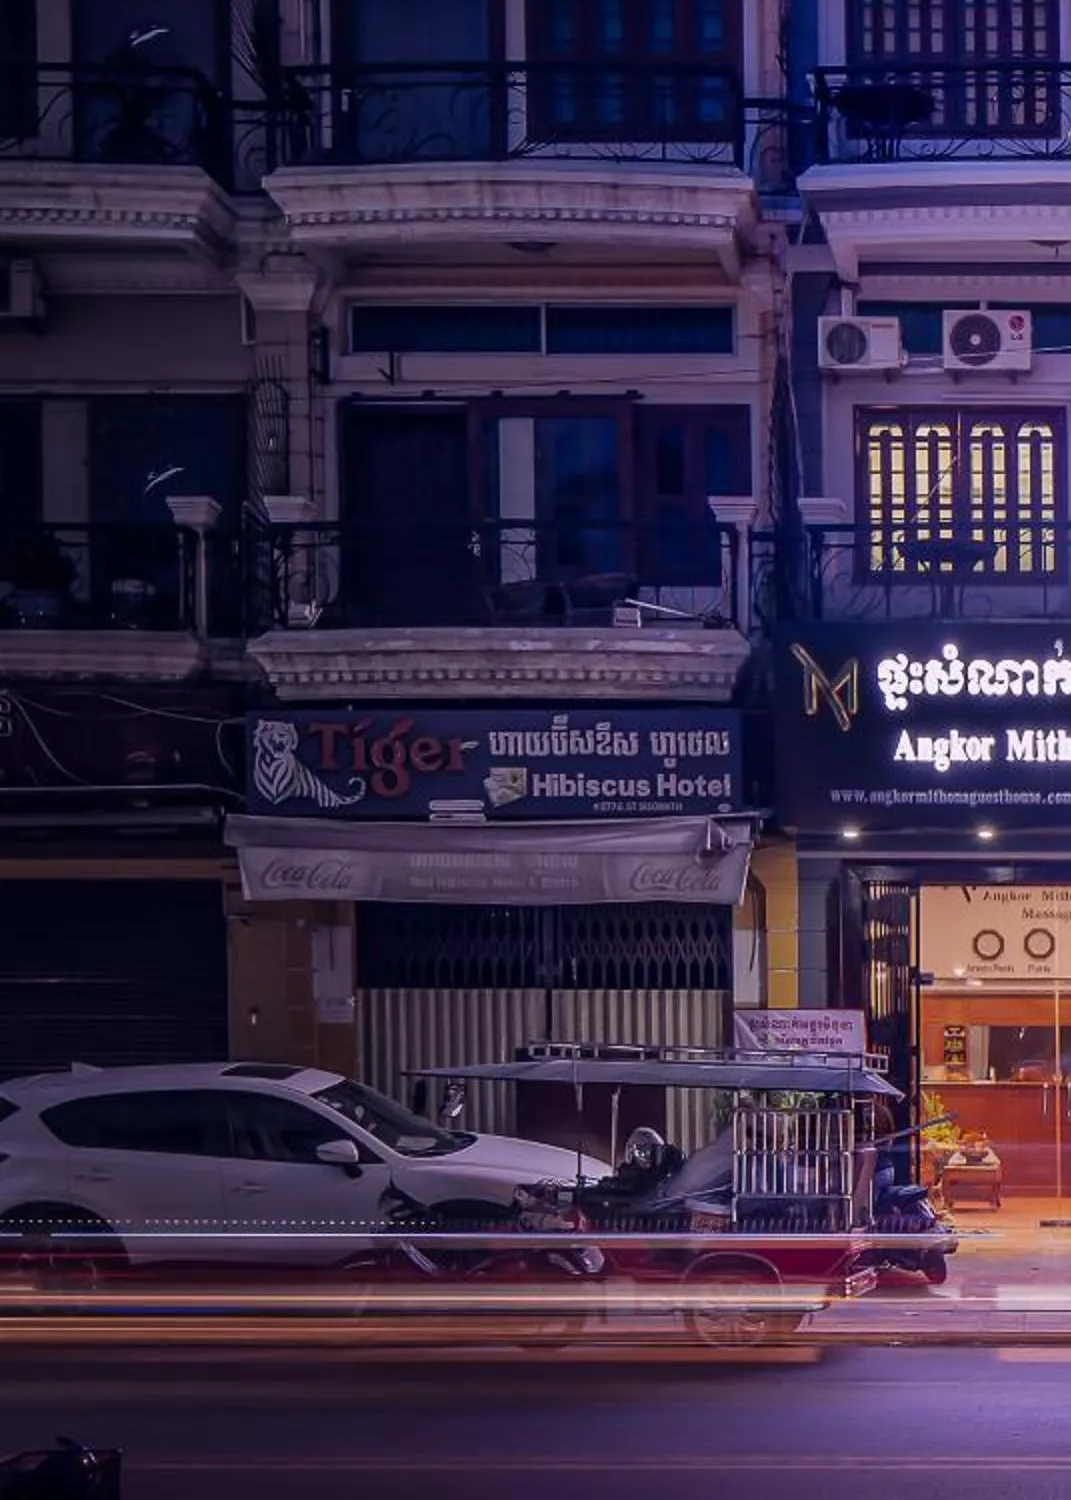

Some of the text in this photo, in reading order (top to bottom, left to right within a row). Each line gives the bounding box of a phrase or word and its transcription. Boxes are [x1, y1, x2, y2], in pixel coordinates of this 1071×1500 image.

[309, 717, 470, 797] Tiger
[893, 729, 996, 772] Angkor
[532, 773, 731, 798] Hibiscus Hotel
[982, 890, 1032, 904] Angkor
